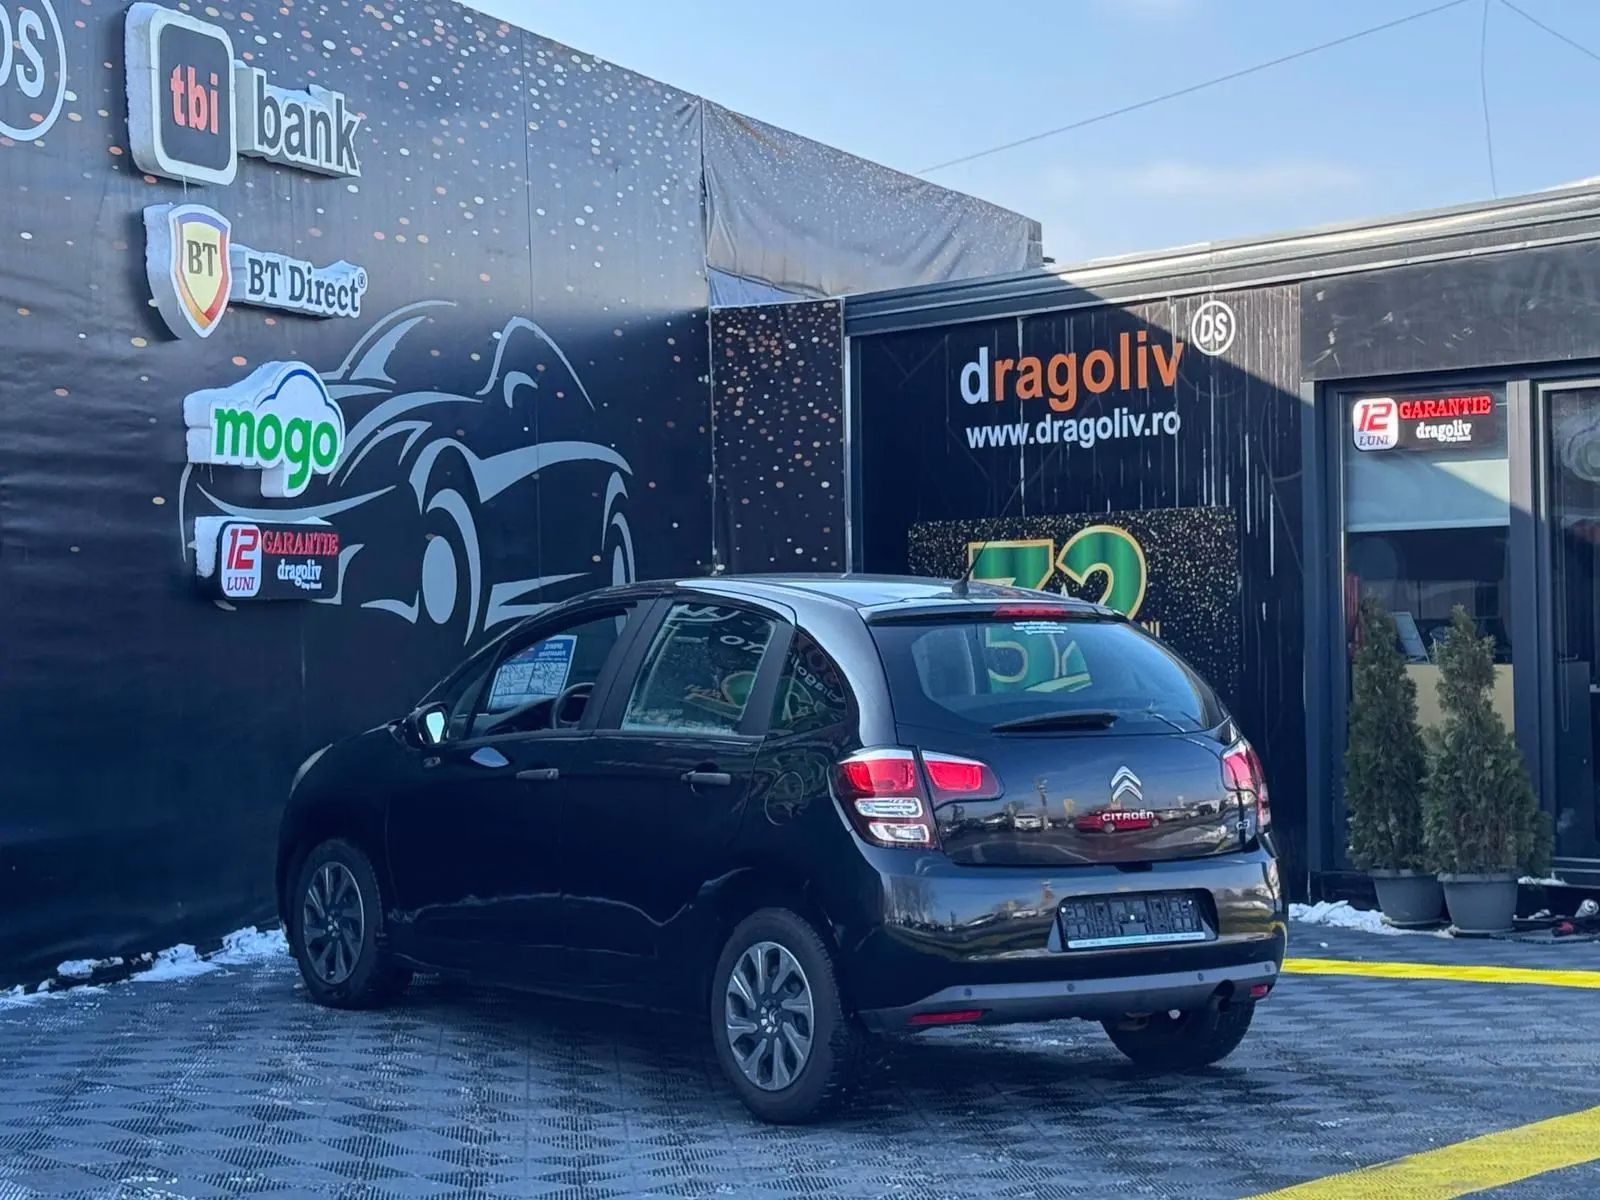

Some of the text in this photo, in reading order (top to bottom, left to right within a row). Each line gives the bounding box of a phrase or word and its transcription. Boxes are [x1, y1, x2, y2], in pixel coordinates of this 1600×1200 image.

[170, 63, 359, 173] tbi bank
[186, 240, 218, 278] BT
[247, 257, 282, 298] BT
[1199, 312, 1229, 344] DS
[959, 329, 1185, 413] dragoliv
[1358, 403, 1393, 432] 12
[1399, 395, 1493, 419] GARANTIE
[965, 408, 1182, 450] www.dragoliv.ro
[1359, 434, 1389, 447] LUNI
[1416, 419, 1472, 442] dragoliv
[214, 407, 339, 490] mogo
[226, 528, 260, 571] 12
[261, 530, 340, 556] GARANTIE
[226, 576, 256, 592] LUNI
[277, 558, 323, 587] dragoliv
